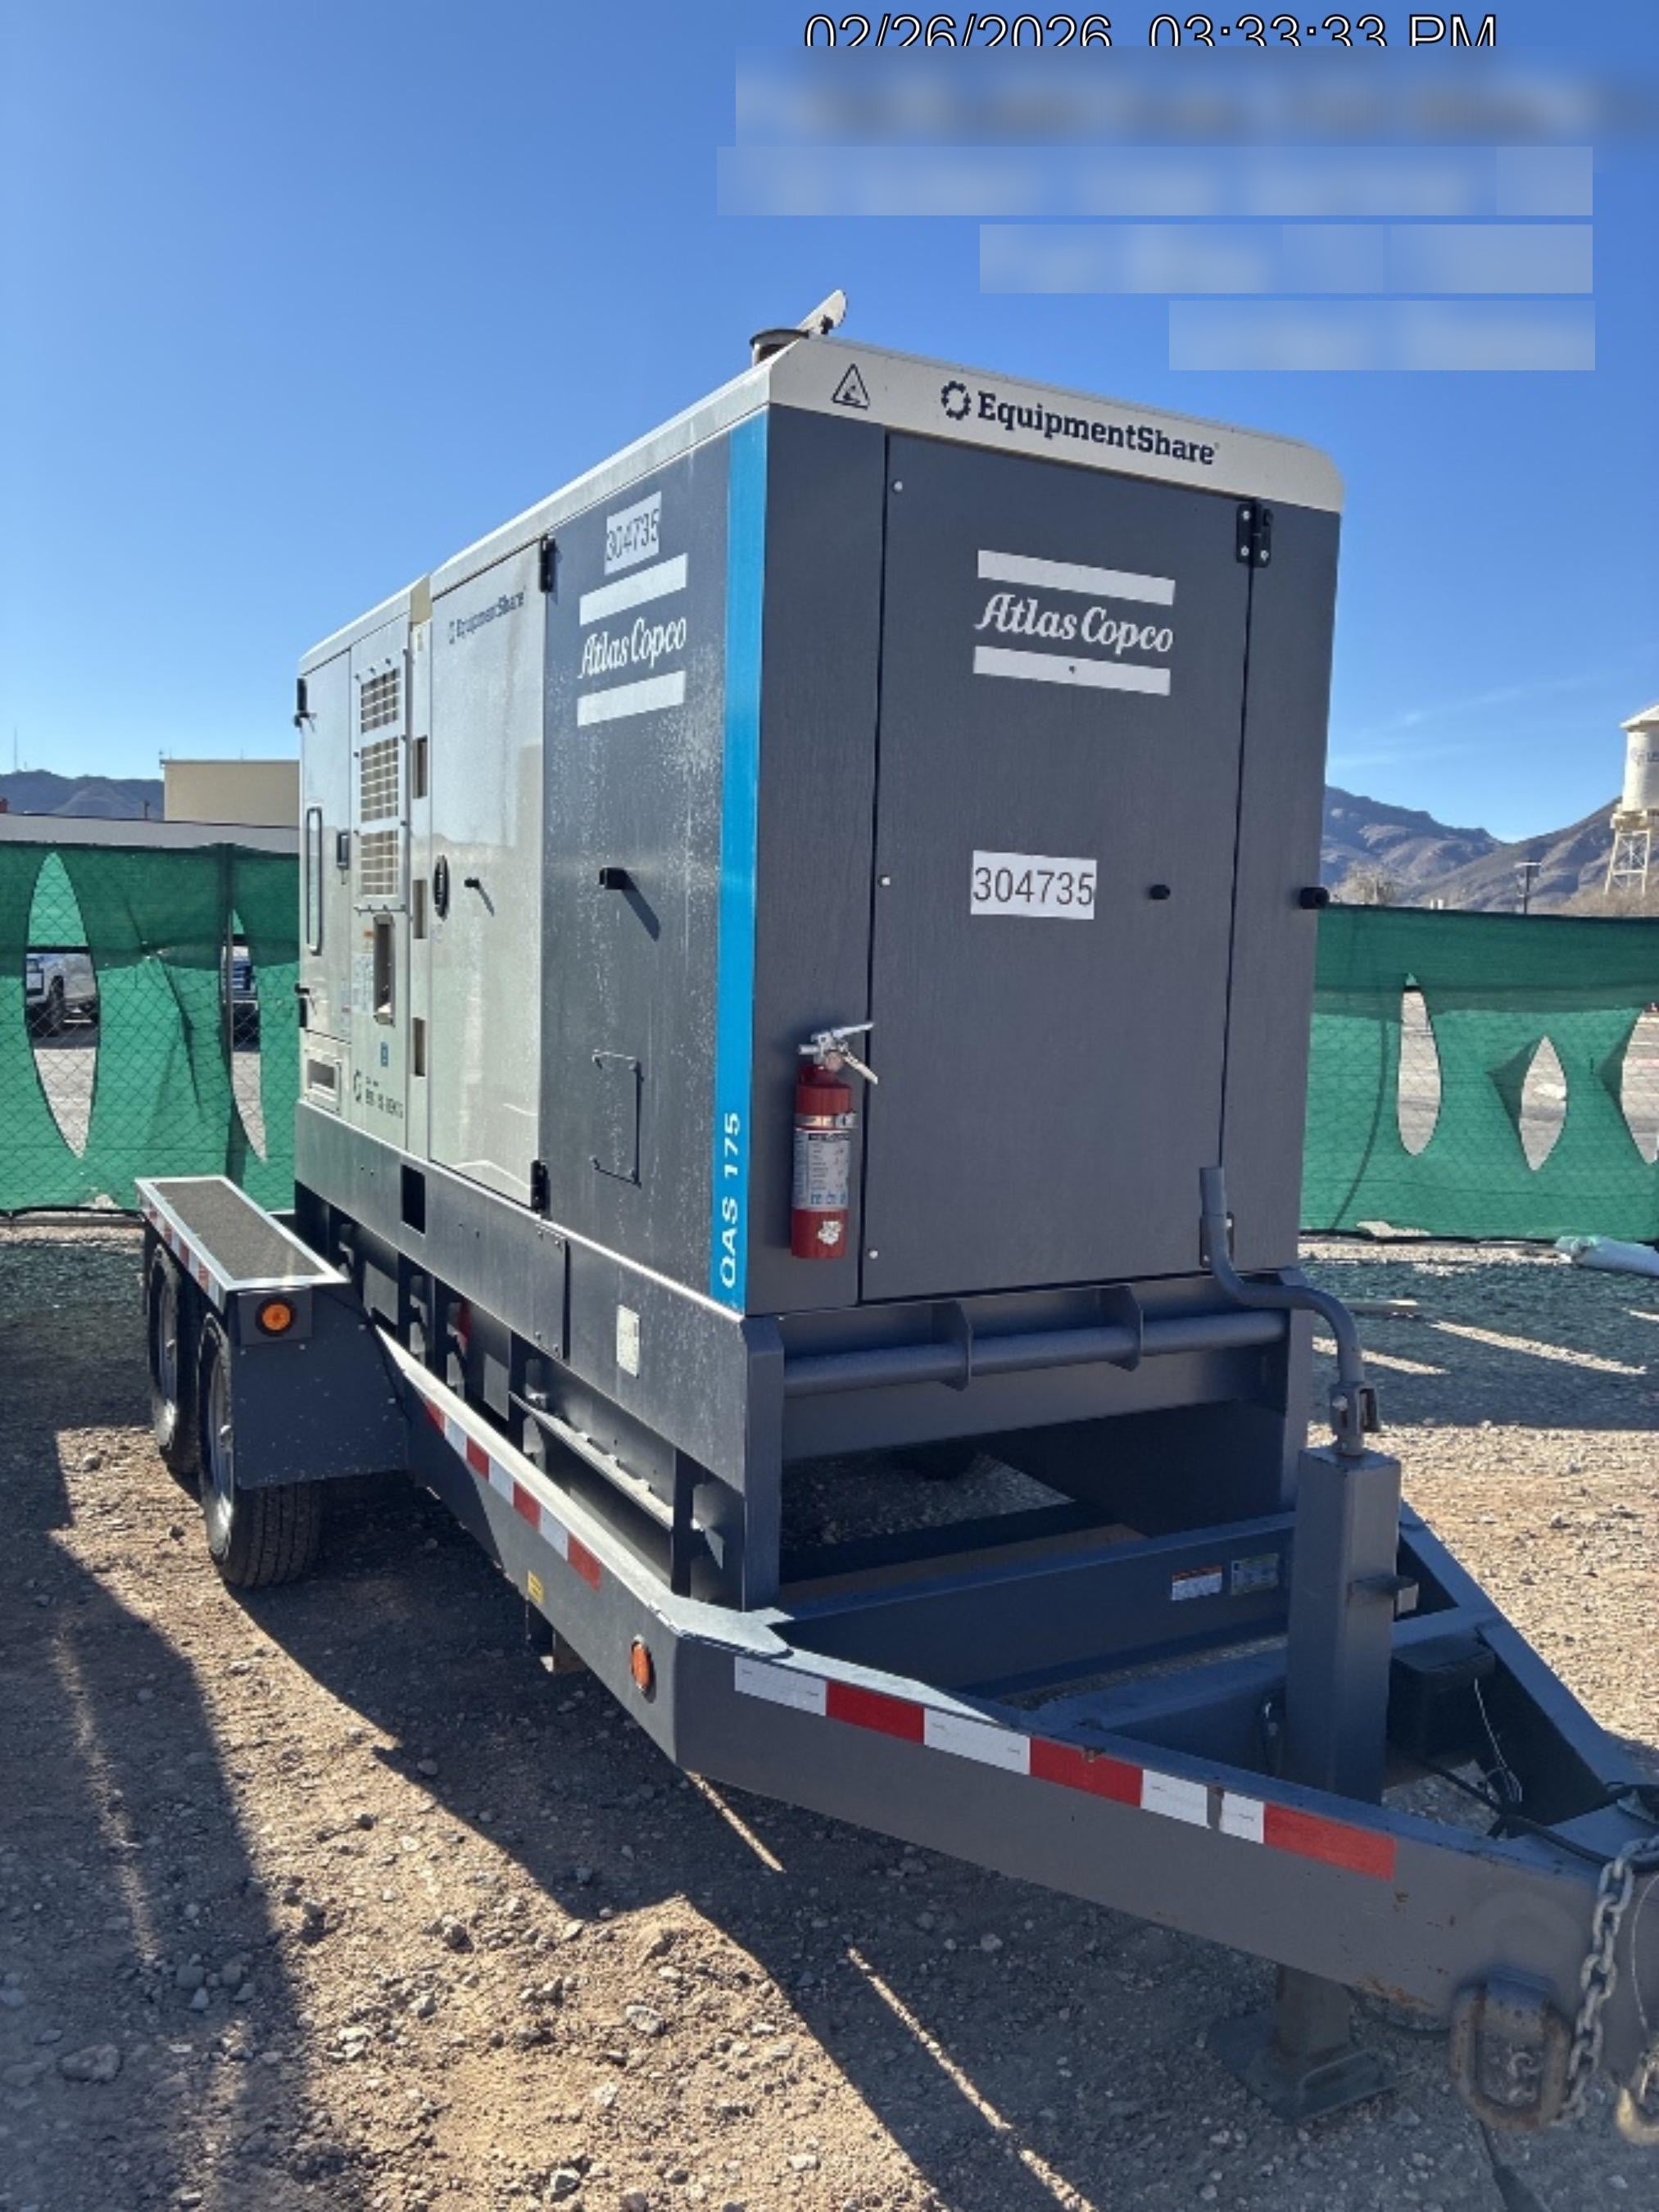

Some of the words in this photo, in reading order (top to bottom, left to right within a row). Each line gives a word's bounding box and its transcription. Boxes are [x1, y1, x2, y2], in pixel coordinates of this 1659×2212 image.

[977, 390, 1216, 465] EquipmentShare
[607, 509, 659, 560] 304735
[577, 631, 628, 679] Atlas
[630, 616, 687, 669] Copco
[974, 593, 1077, 641] Atlas
[1081, 605, 1173, 655] Copco
[972, 866, 1095, 906] 304735
[723, 1111, 741, 1178] 175
[719, 1197, 738, 1289] QAS
